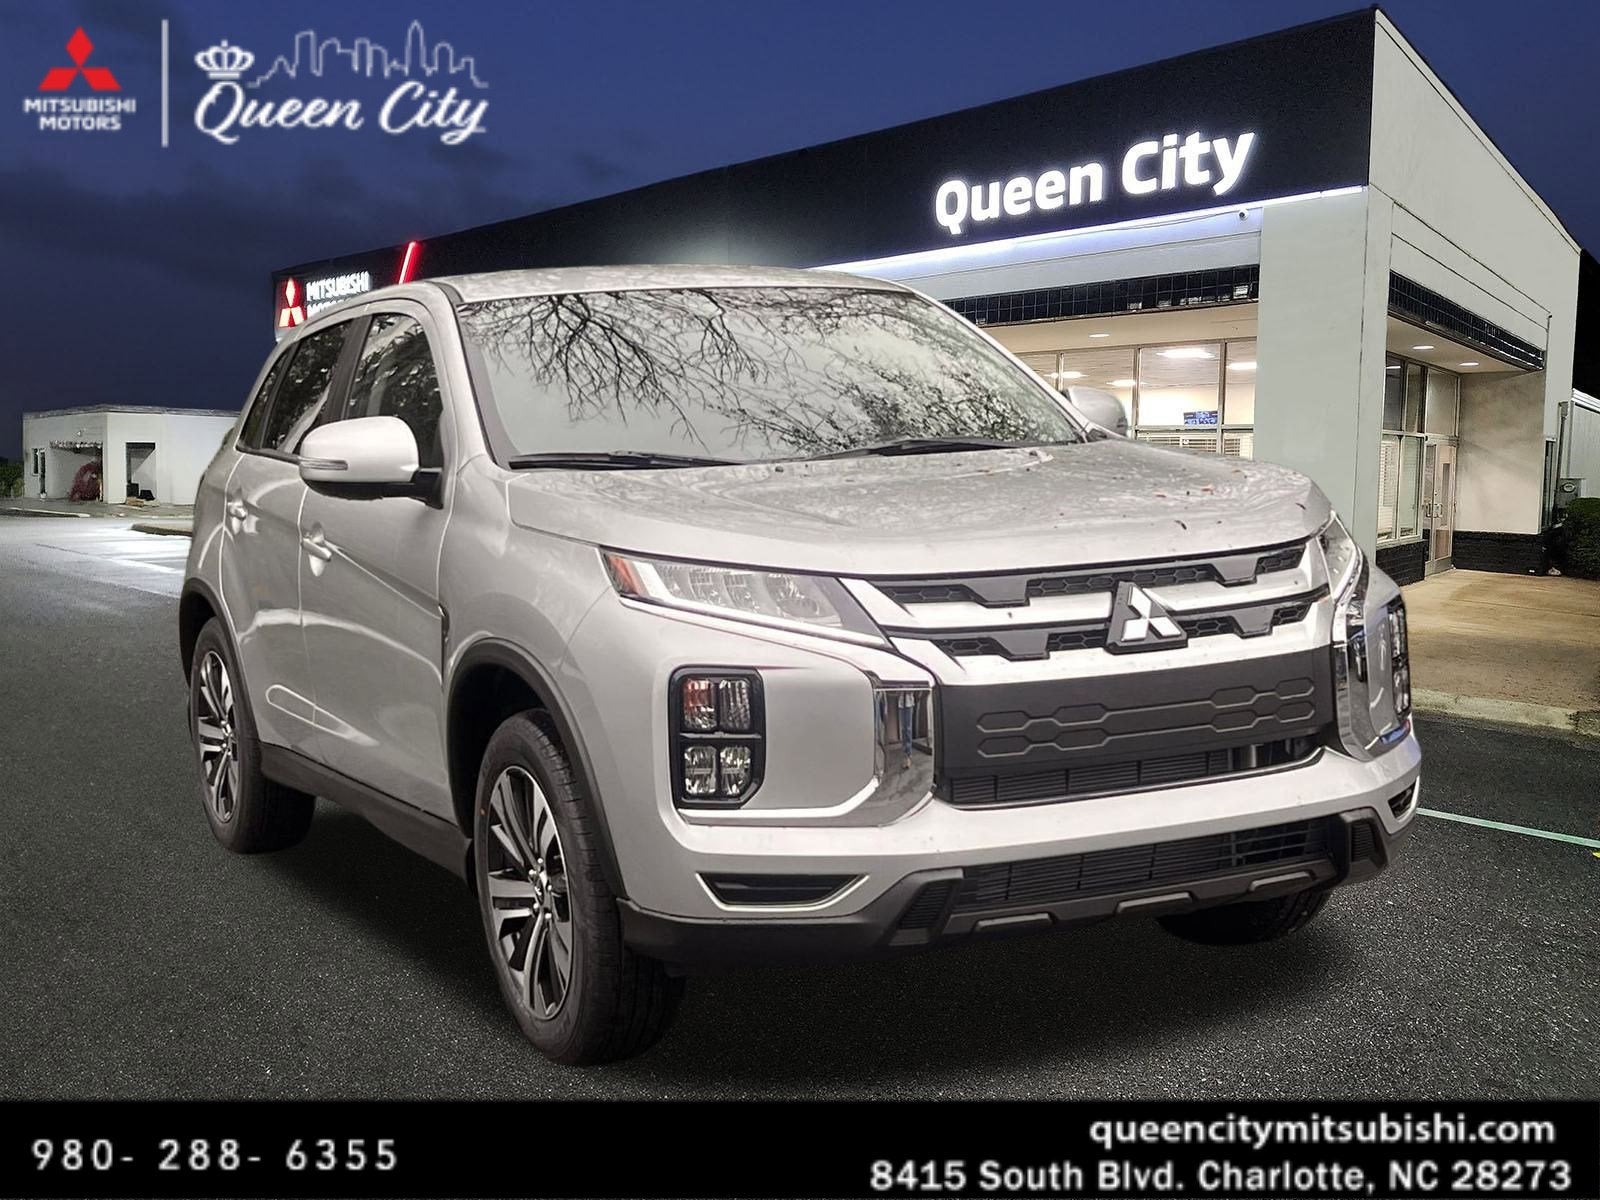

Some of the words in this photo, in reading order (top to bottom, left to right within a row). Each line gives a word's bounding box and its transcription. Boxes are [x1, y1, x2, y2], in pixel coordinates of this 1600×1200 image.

[934, 161, 1104, 235] Queen
[1121, 130, 1256, 196] City
[306, 270, 371, 302] MITSUBISHI
